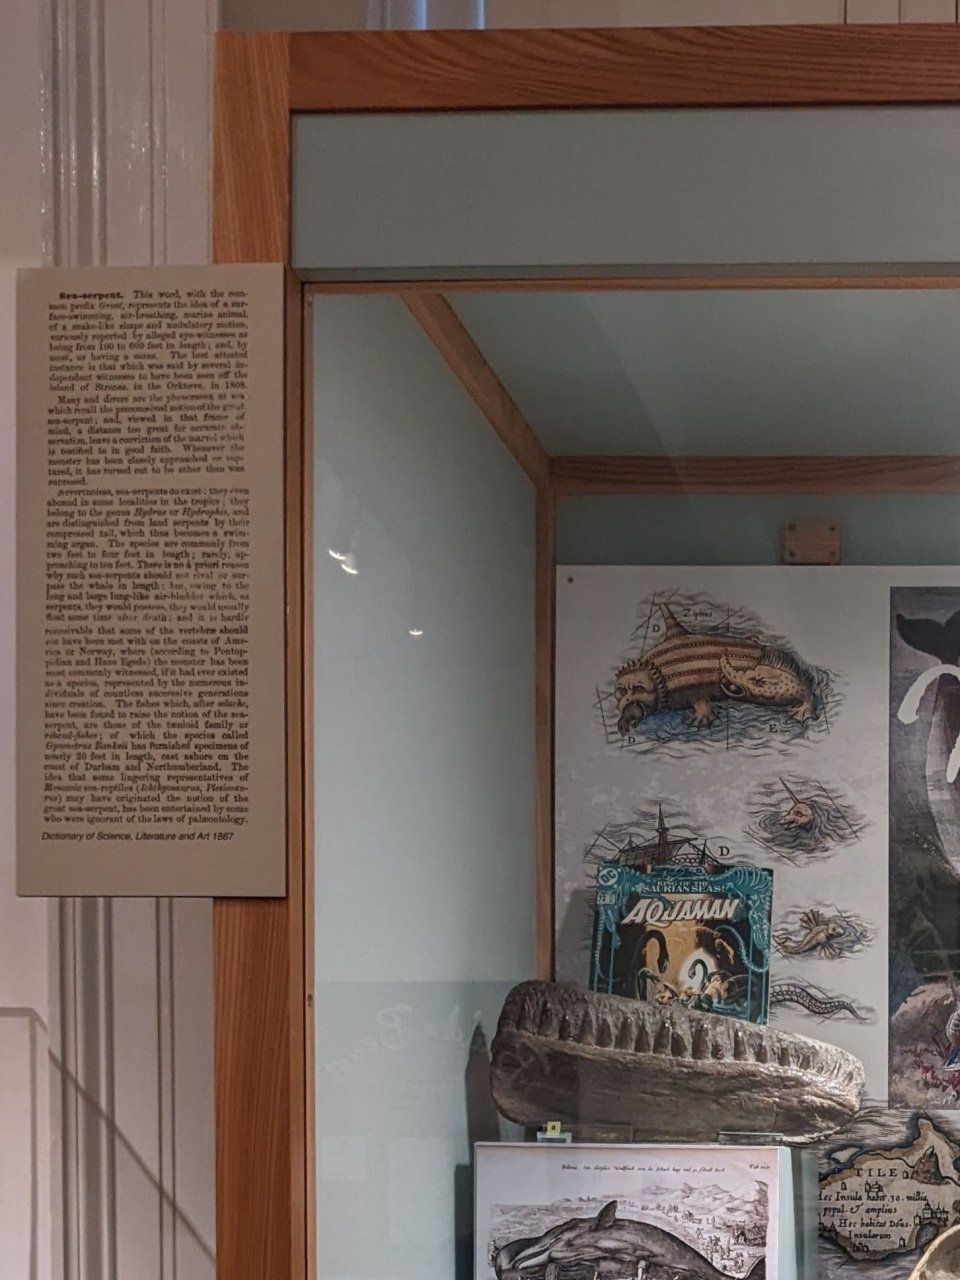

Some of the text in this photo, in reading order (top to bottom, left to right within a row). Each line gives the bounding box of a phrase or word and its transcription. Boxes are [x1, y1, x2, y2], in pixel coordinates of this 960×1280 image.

[41, 832, 234, 842] Dictionary of Science, Literature and Art 1867
[600, 869, 617, 884] DC
[621, 899, 739, 928] AQUAMAN
[854, 1168, 898, 1177] TILE
